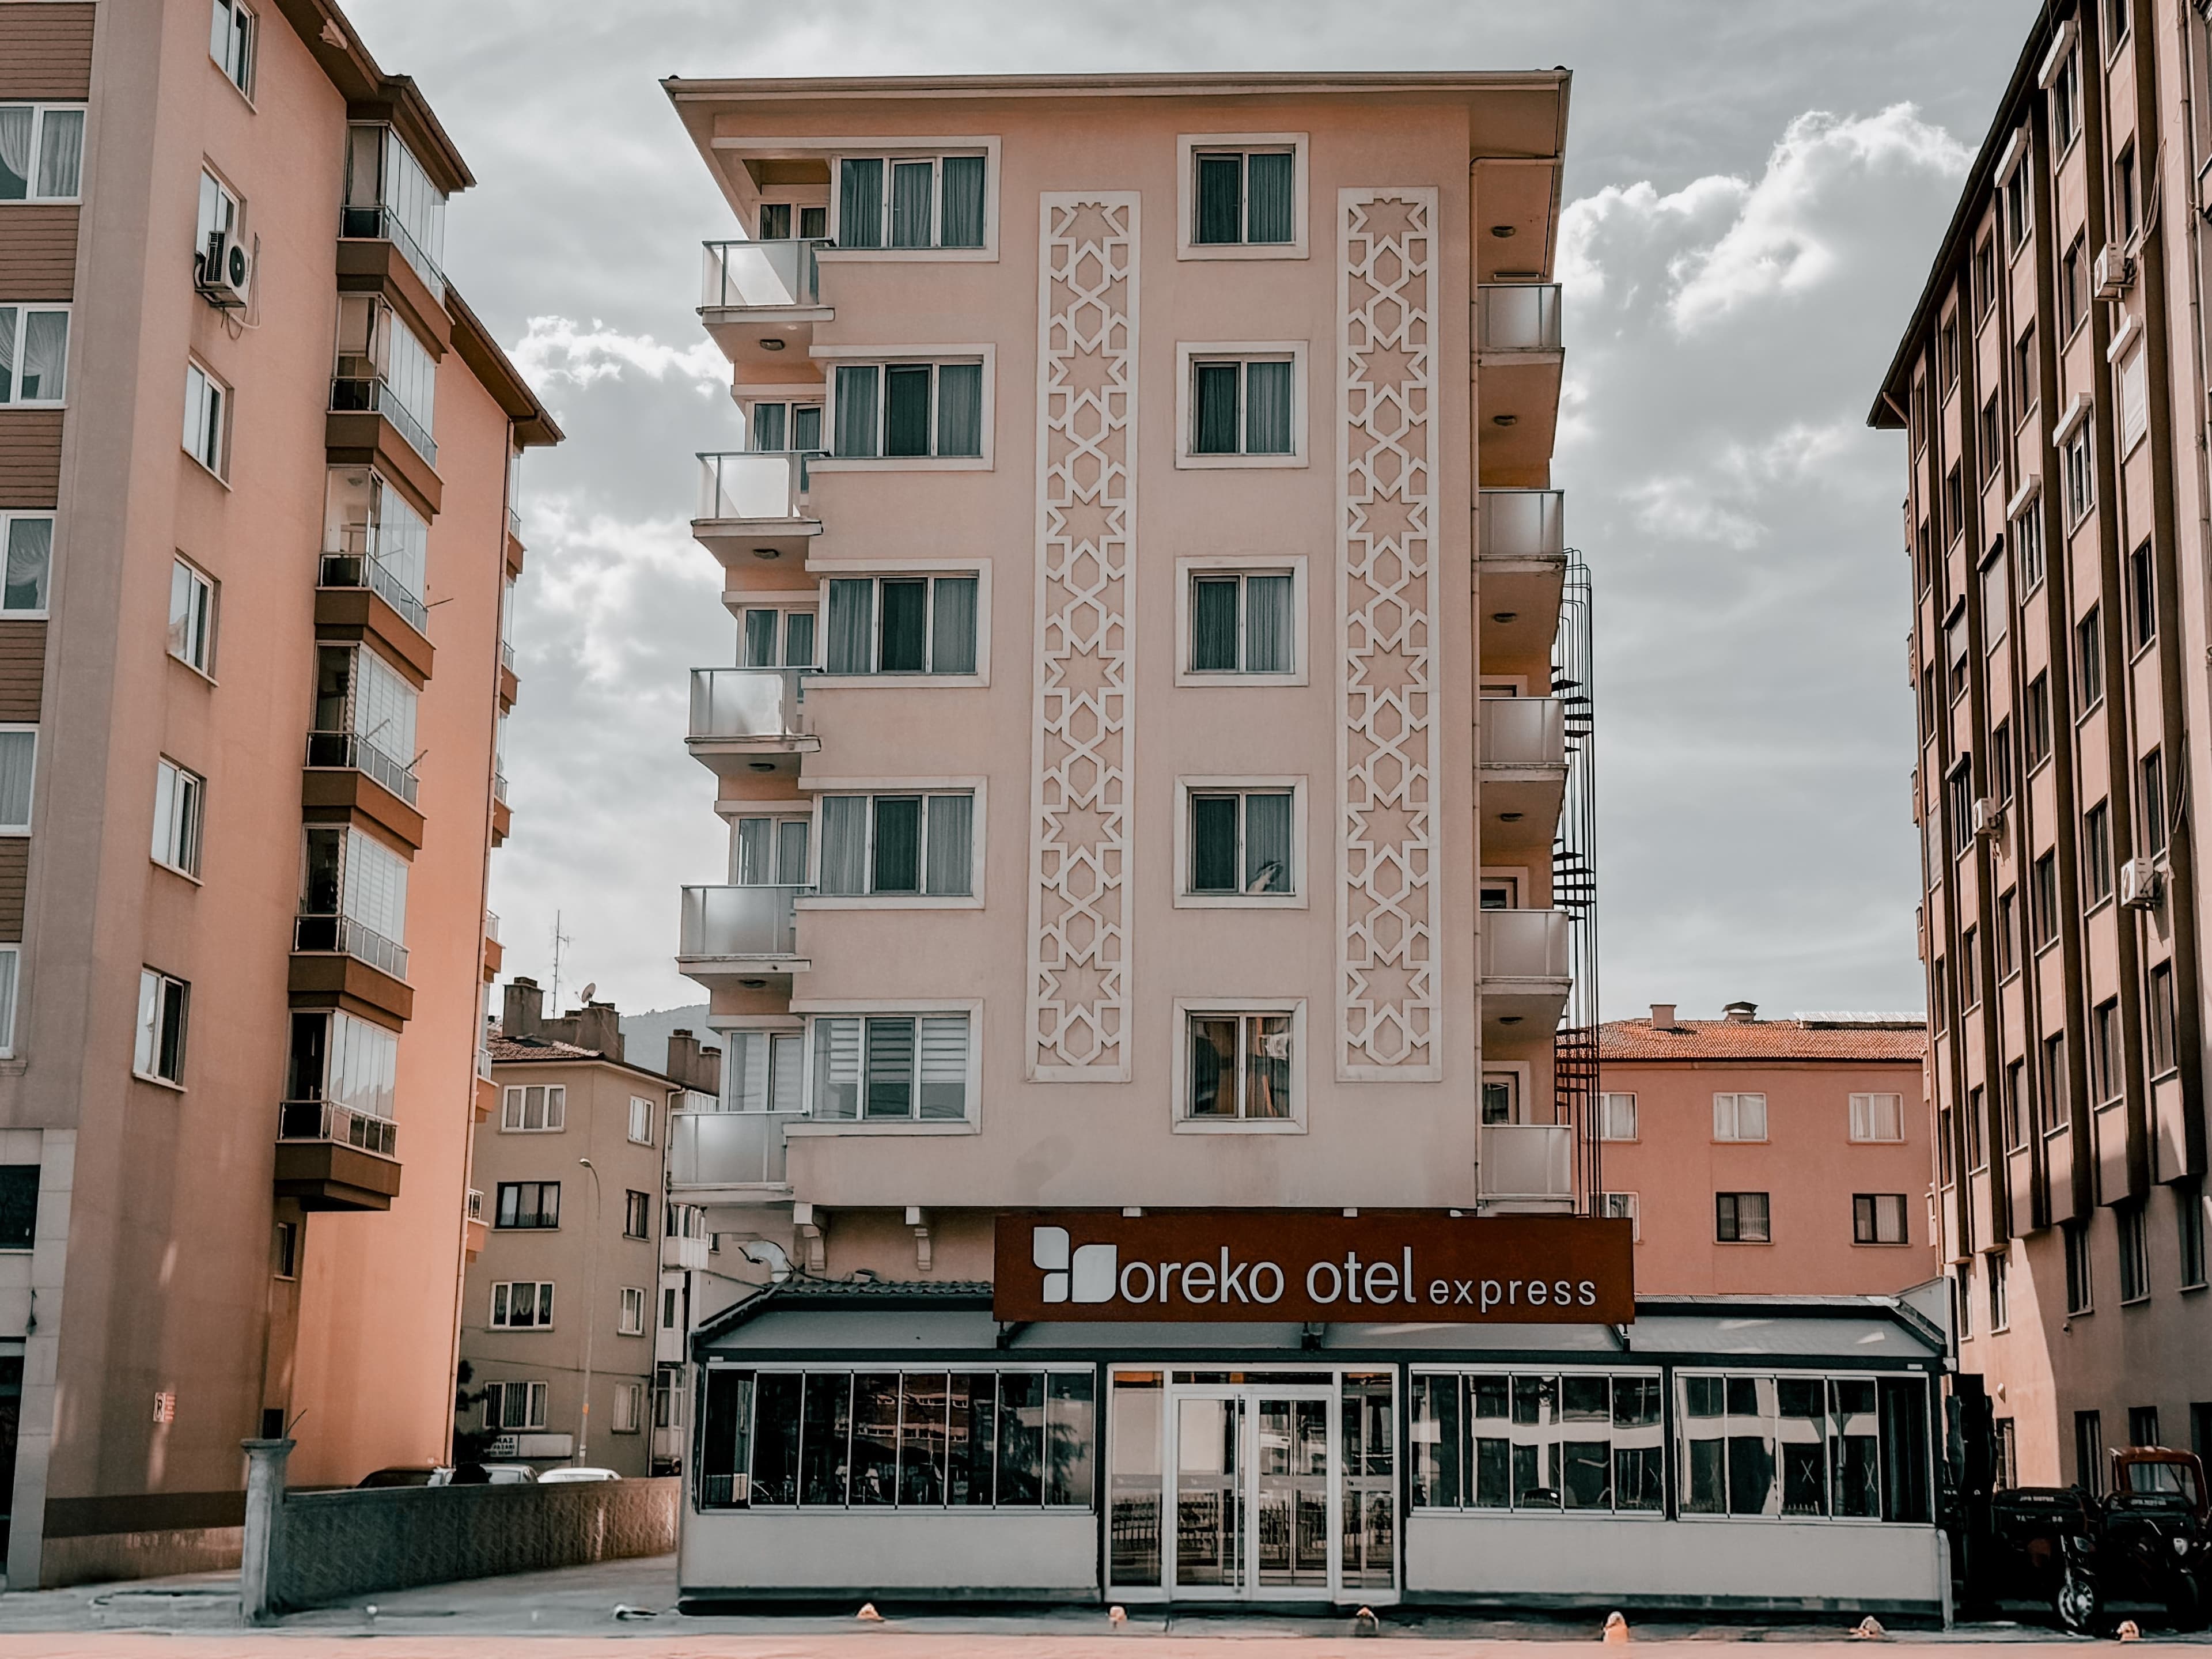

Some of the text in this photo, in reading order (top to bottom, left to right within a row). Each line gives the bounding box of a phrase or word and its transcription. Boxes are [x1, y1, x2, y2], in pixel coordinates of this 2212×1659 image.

[1120, 1246, 1596, 1313] oreko otel express
